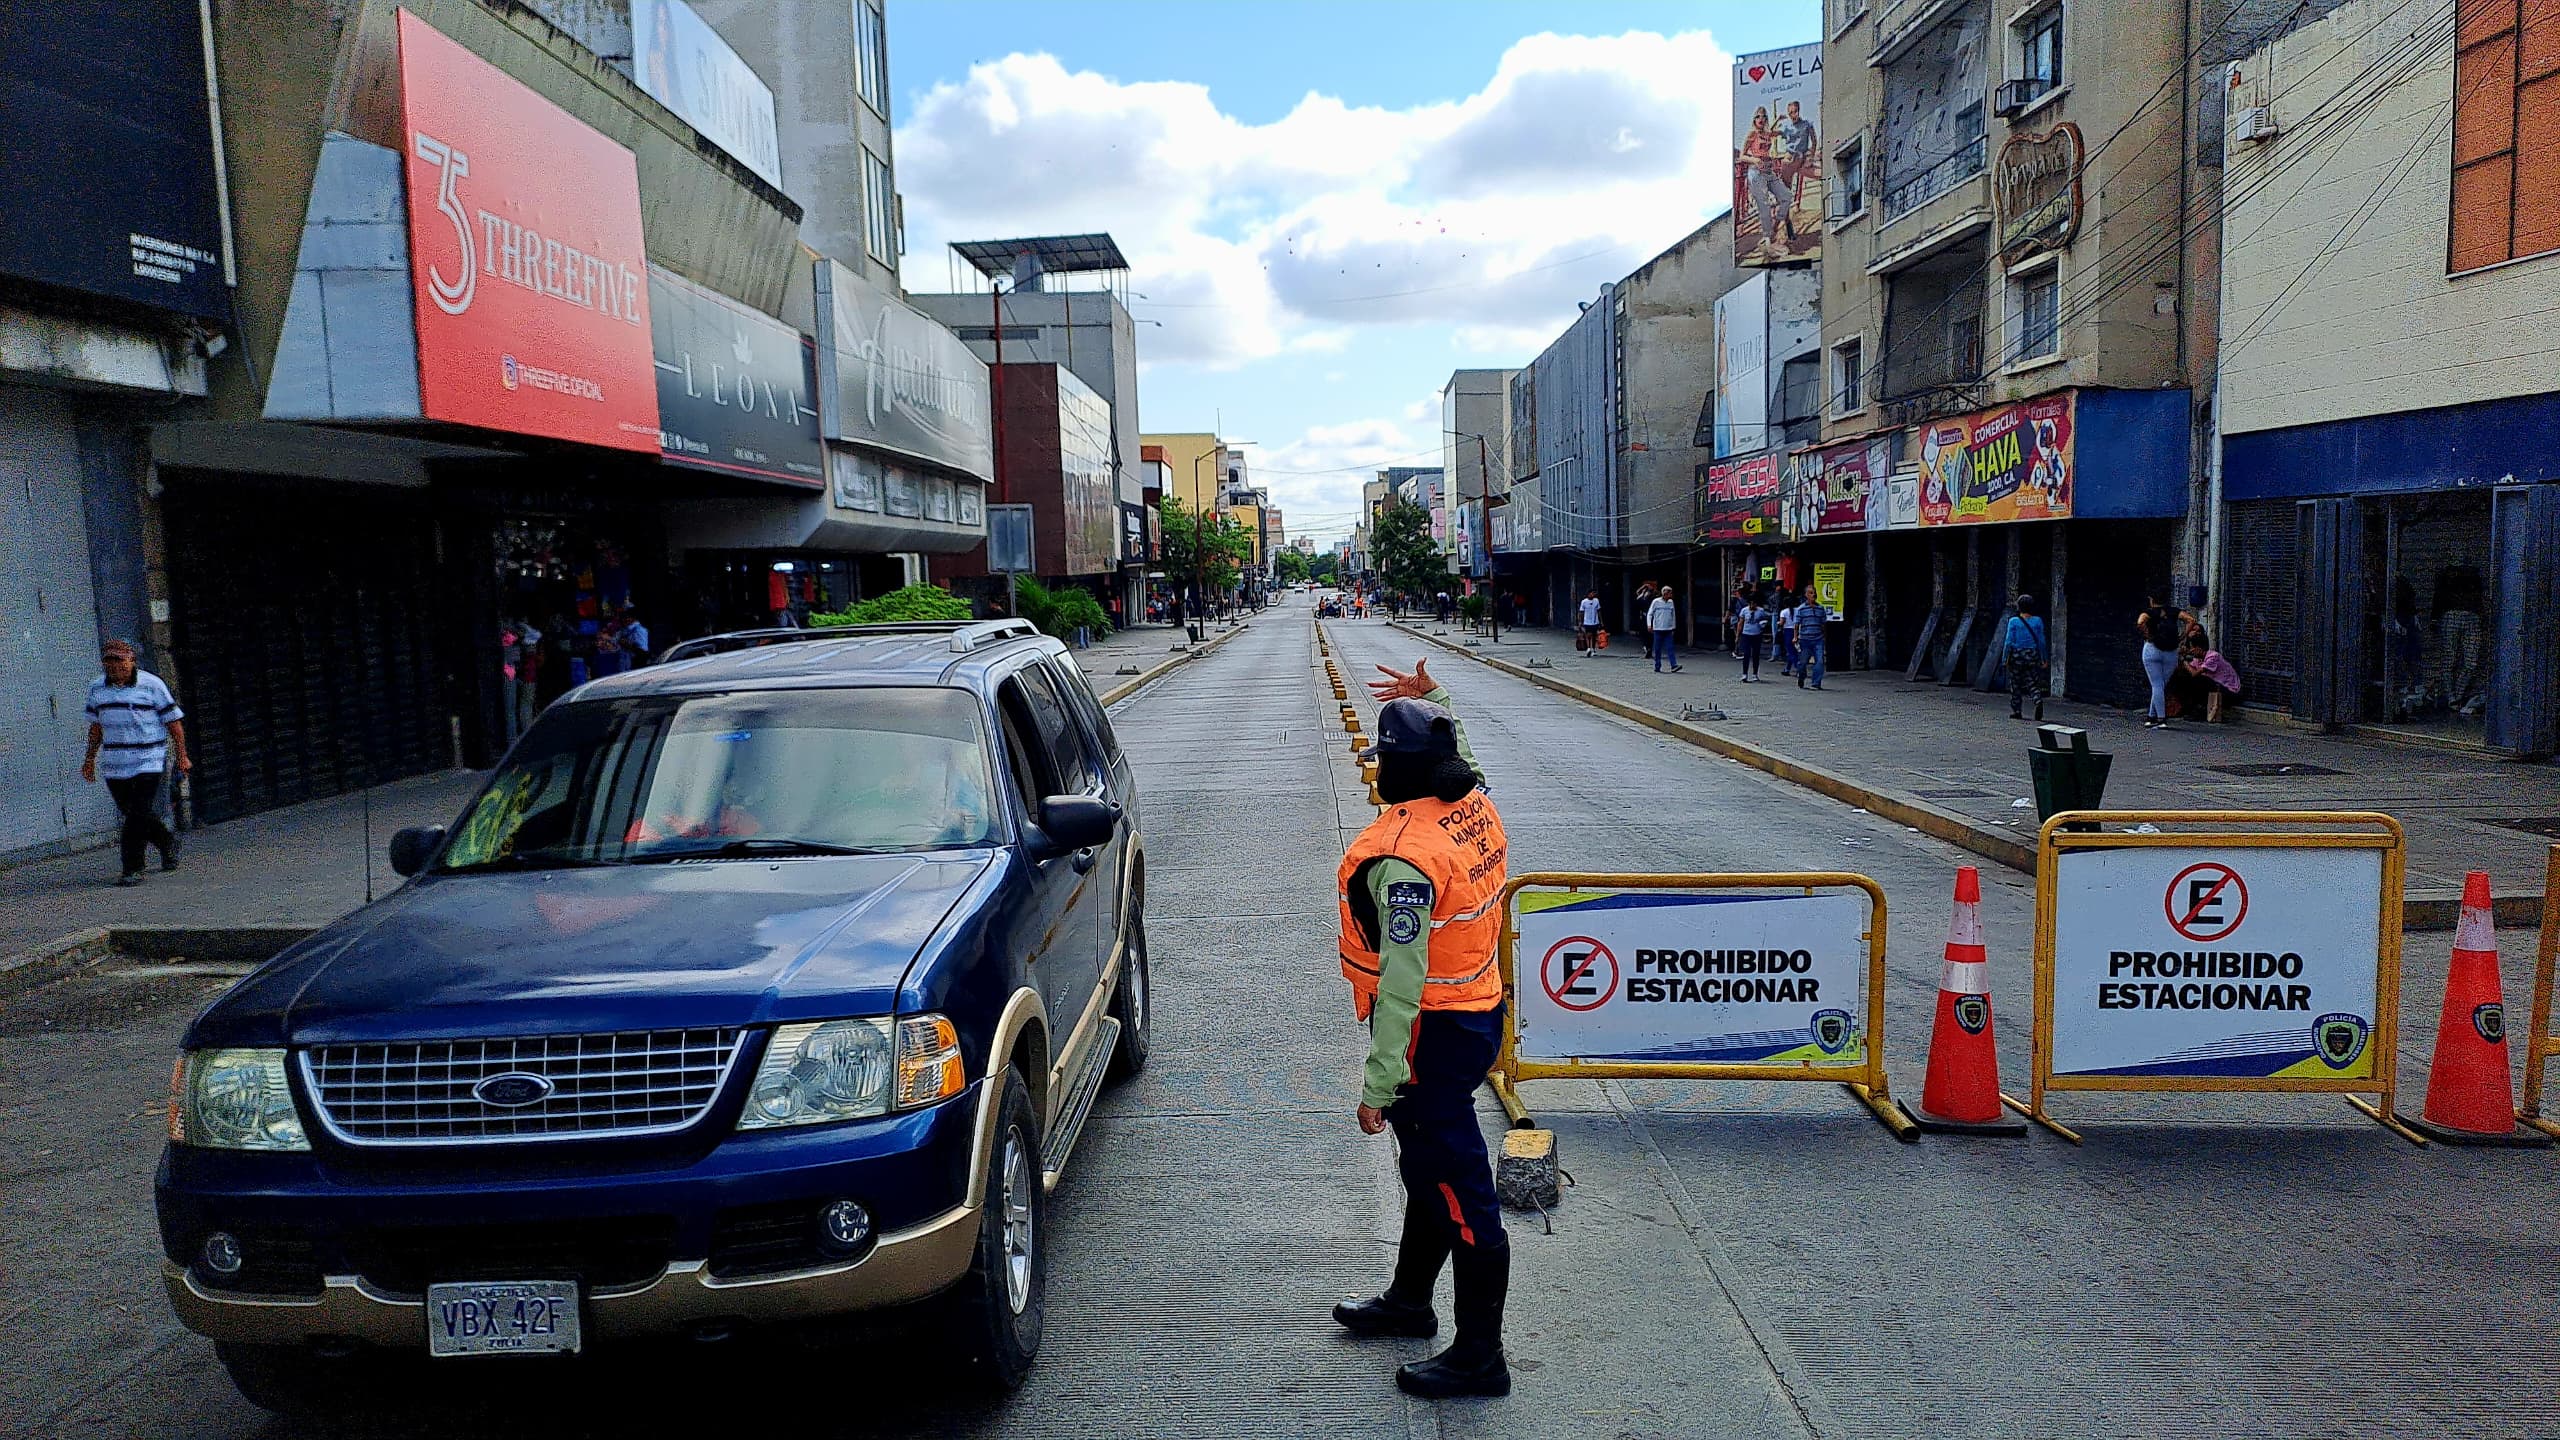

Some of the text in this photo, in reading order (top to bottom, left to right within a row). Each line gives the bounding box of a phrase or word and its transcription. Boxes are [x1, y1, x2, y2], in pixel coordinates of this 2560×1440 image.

[478, 208, 641, 326] THREEFIVE
[1974, 410, 2019, 444] COMERCIAL
[1973, 430, 2022, 486] HAVA
[1707, 453, 1780, 503] PRINCESA
[1477, 837, 1489, 857] DE
[1635, 949, 1812, 974] PROHIBIDO
[2109, 951, 2304, 979] PROHIBIDO
[1627, 978, 1820, 1003] ESTACIONAR
[2098, 983, 2312, 1011] ESTACIONAR
[2323, 1015, 2357, 1024] POLICIA
[441, 1296, 566, 1338] VBX 42F
